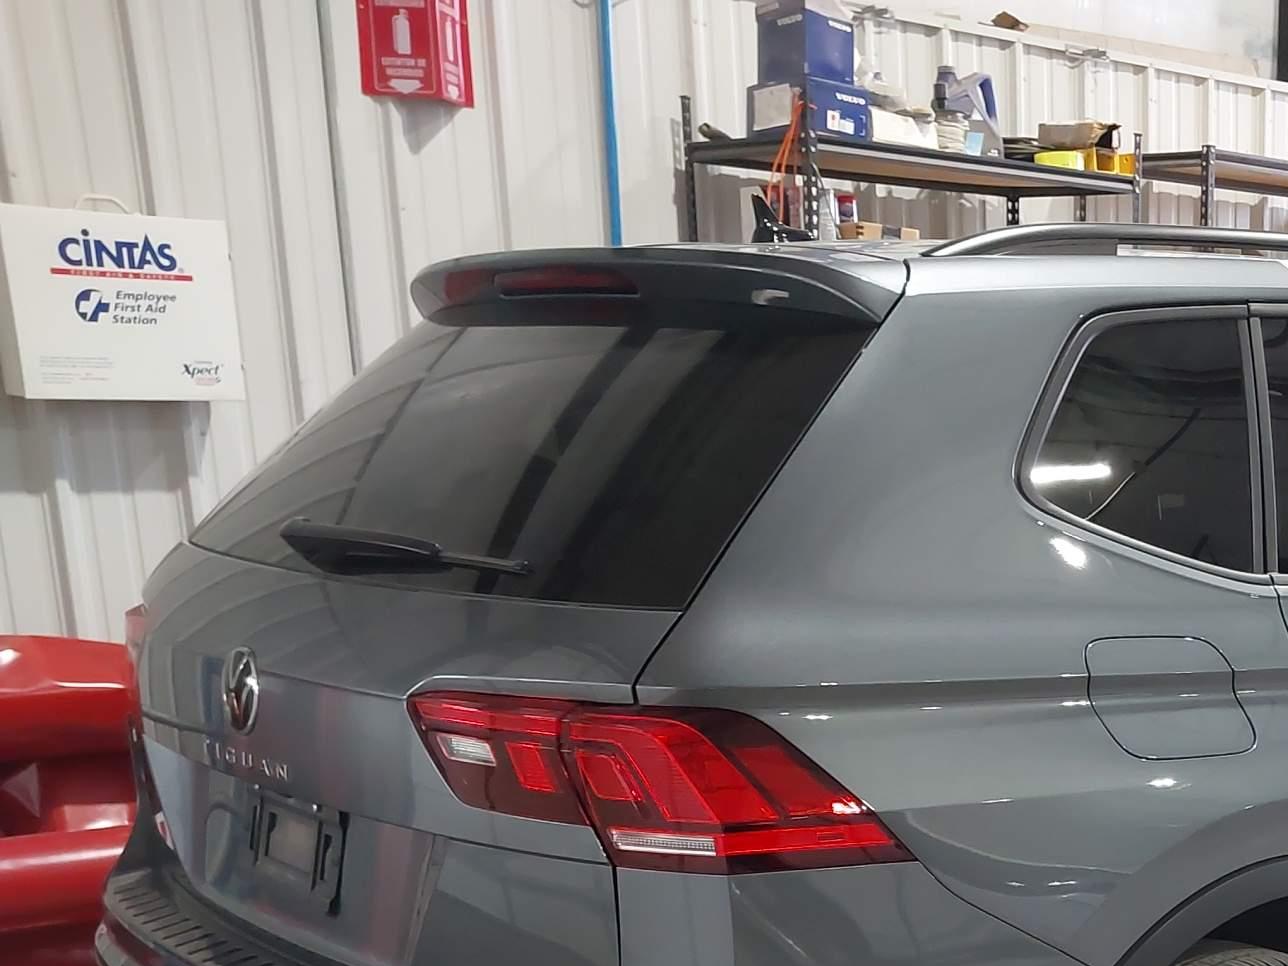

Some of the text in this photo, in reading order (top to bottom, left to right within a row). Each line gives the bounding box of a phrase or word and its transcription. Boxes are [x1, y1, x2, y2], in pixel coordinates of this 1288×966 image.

[115, 290, 177, 303] Employee
[113, 303, 167, 313] First Aid
[112, 314, 158, 325] Station
[202, 736, 289, 781] TIGUAN
